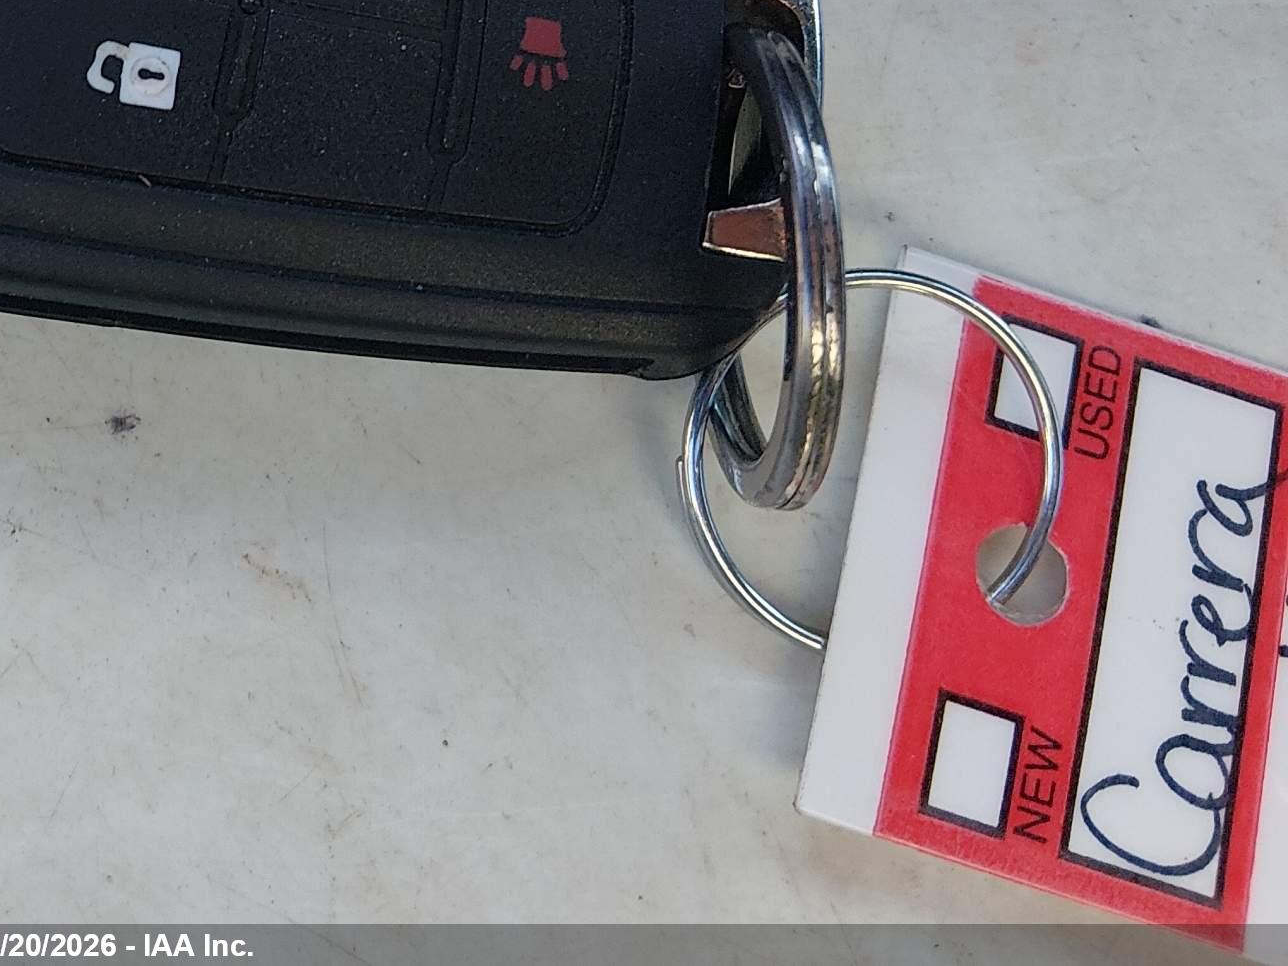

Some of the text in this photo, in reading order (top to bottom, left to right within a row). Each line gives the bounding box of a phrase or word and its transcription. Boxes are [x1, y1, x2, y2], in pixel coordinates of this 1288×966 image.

[1074, 345, 1122, 460] USED
[1081, 480, 1288, 877] Carrera
[1014, 729, 1064, 844] NEW
